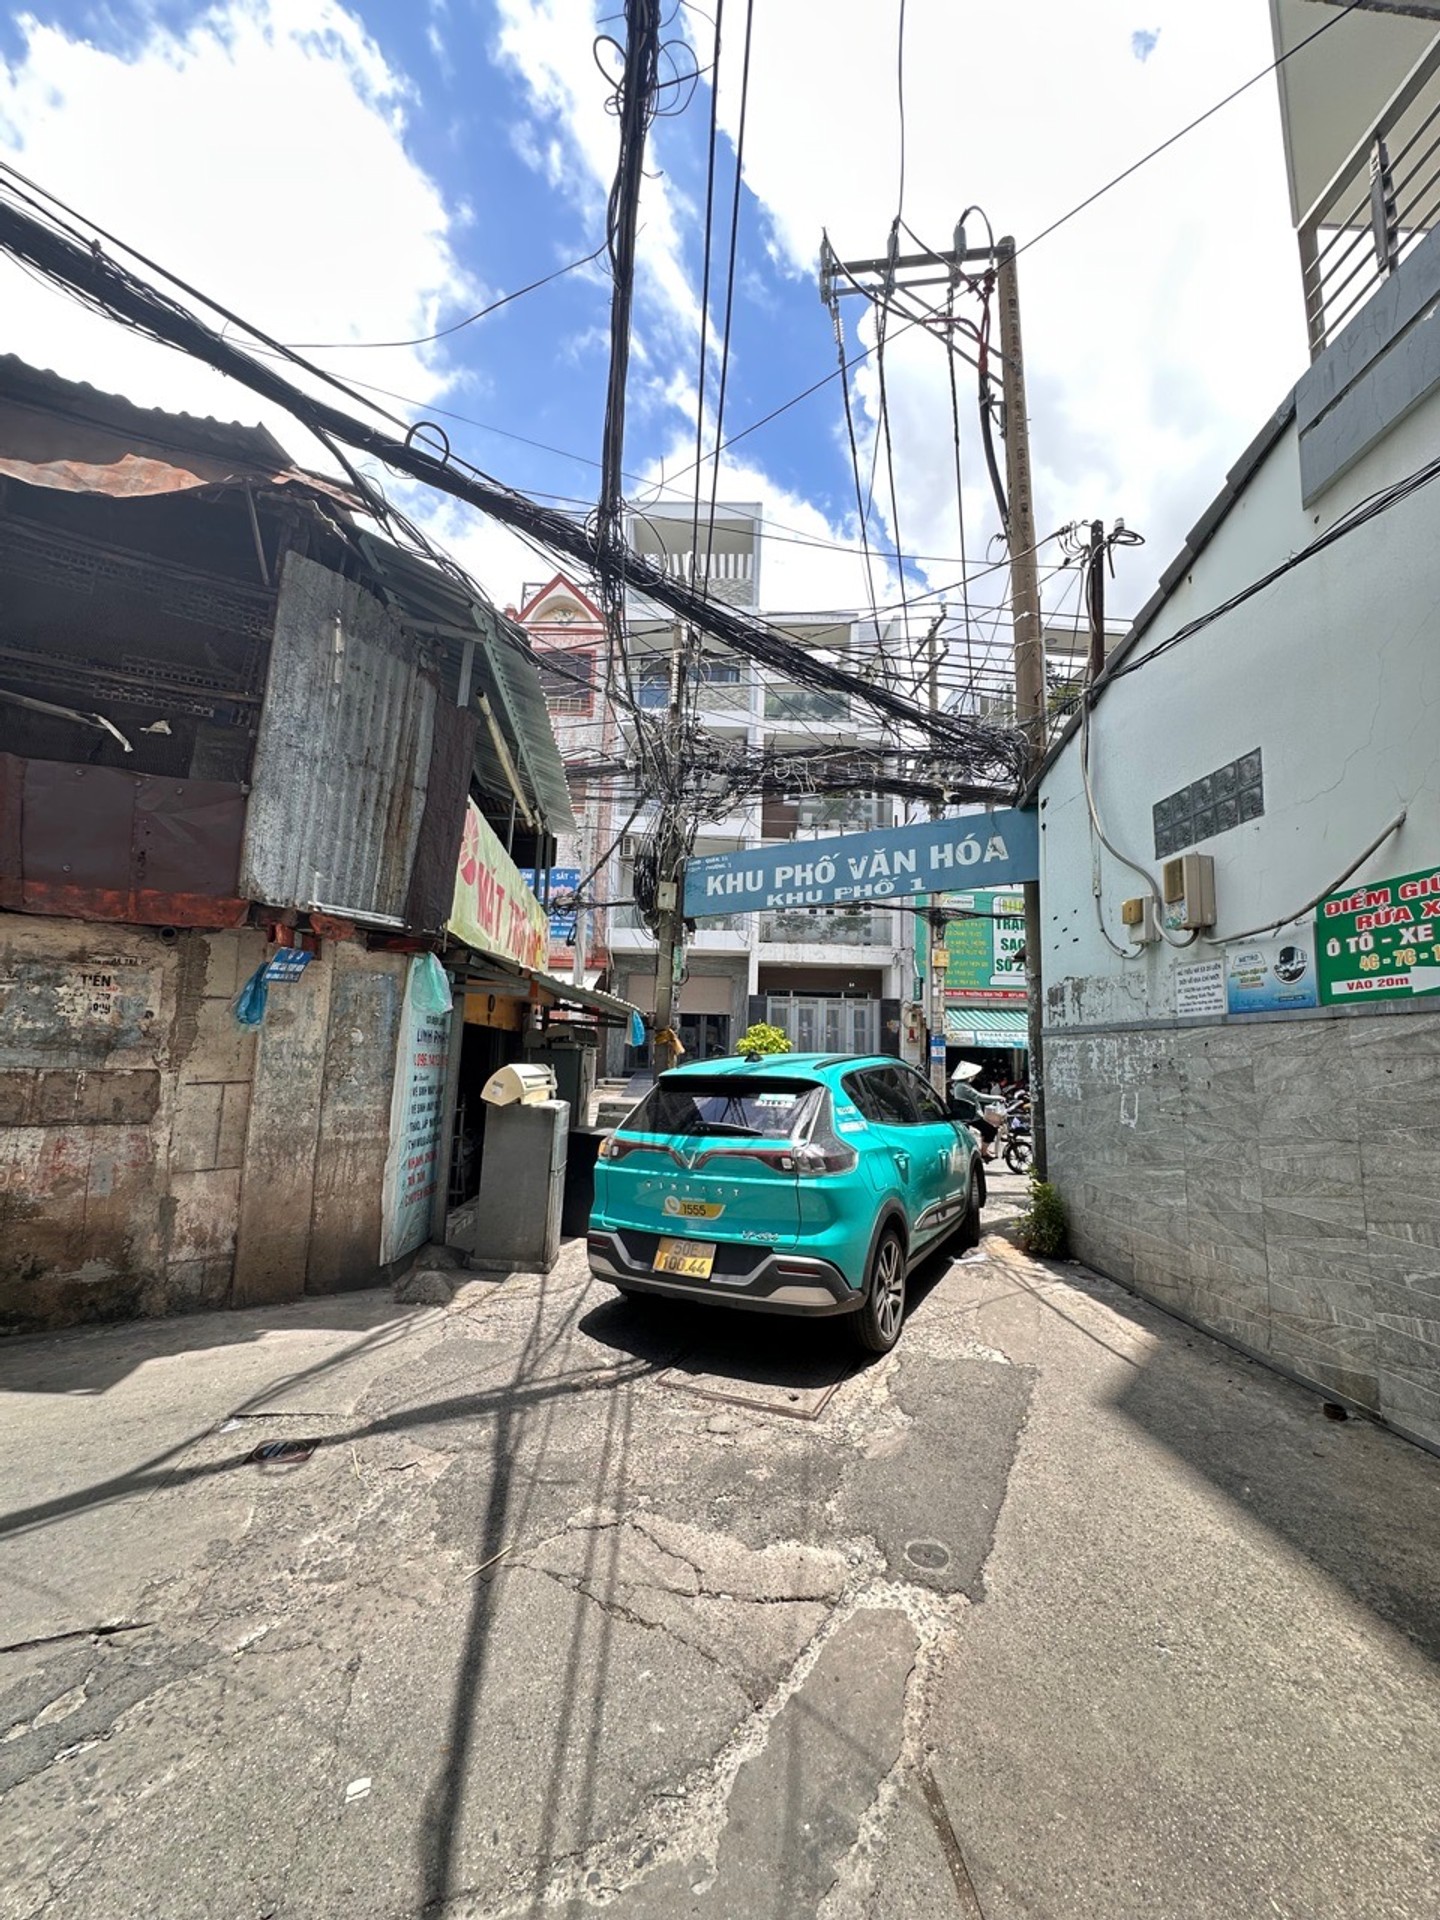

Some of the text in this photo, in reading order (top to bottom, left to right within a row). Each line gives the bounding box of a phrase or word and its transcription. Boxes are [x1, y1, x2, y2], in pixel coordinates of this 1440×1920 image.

[707, 833, 1010, 897] KHU PHỐ VĂN HÓA
[766, 876, 926, 906] KHU PHỐ 1
[1324, 888, 1391, 918] ĐIỂM
[996, 917, 1025, 933] TRẠ
[1355, 898, 1440, 932] RỬA X
[1326, 937, 1341, 957] Ô
[1345, 931, 1374, 954] TÔ
[1399, 923, 1434, 945] XE
[1377, 977, 1409, 988] 20m
[682, 1203, 707, 1217] 1555
